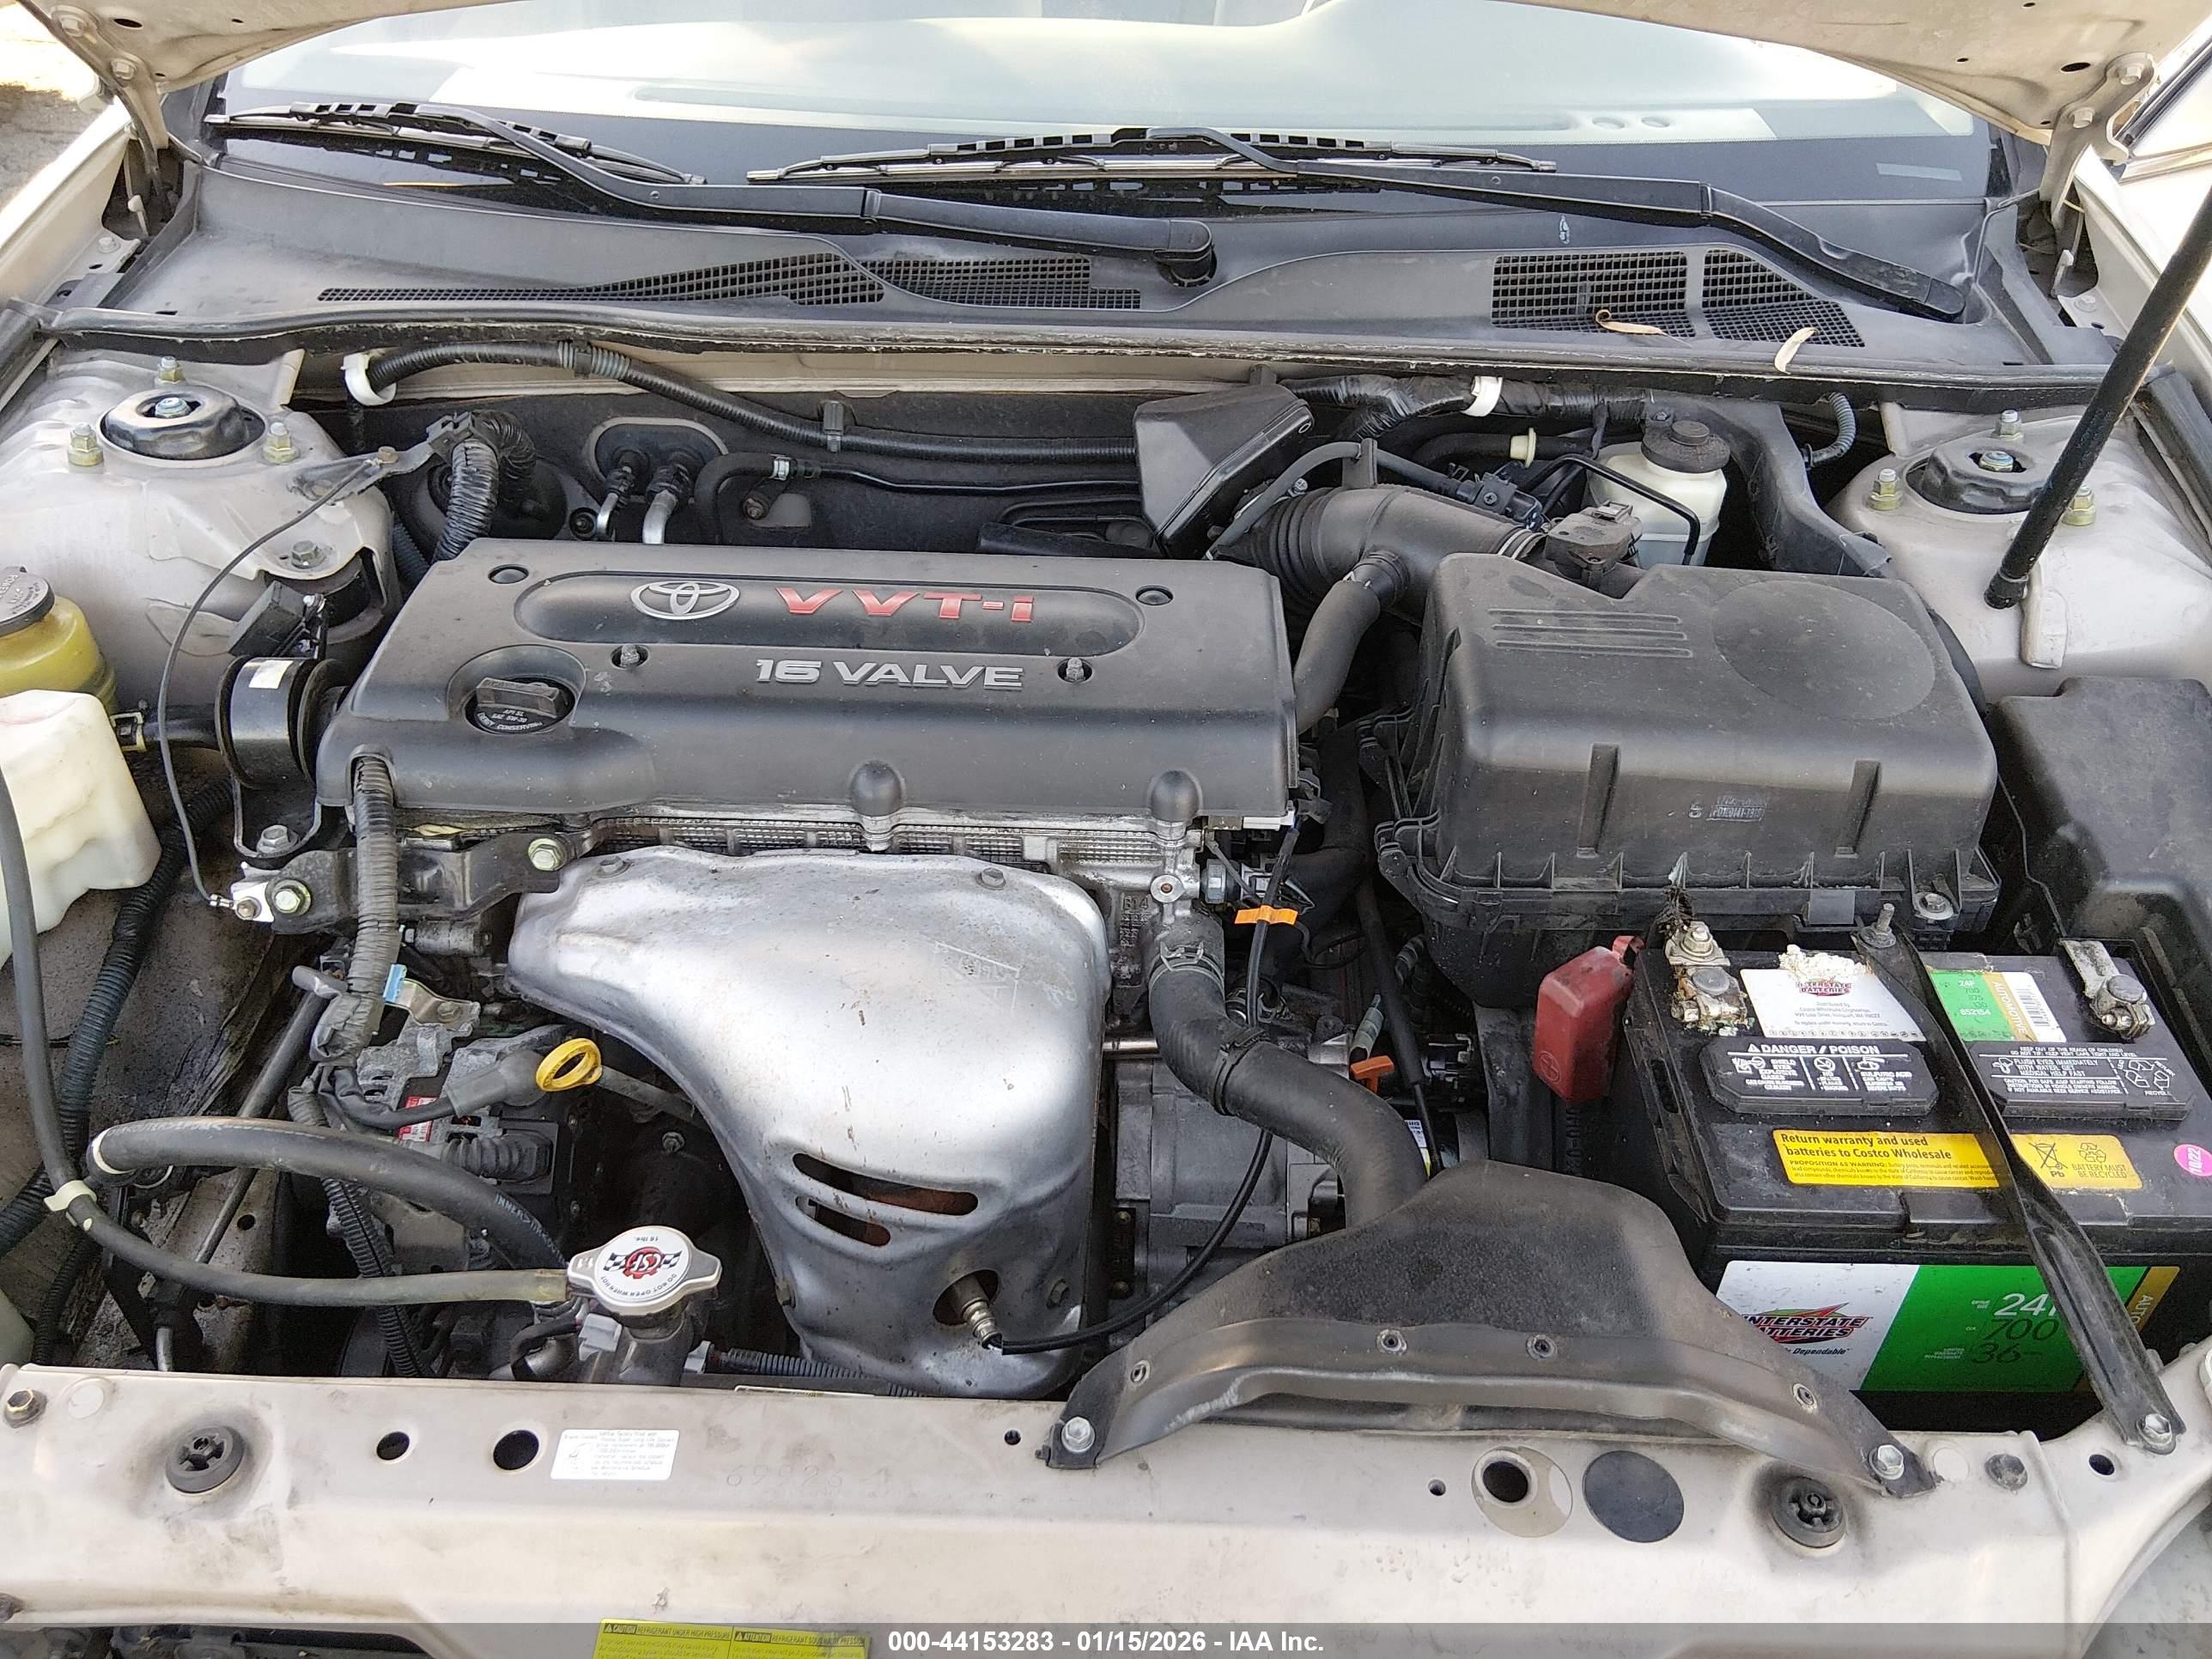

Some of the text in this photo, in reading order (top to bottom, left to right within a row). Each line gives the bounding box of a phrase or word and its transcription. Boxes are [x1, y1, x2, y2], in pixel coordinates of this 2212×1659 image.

[756, 659, 1024, 690] 16 VALVE
[1992, 981, 2027, 1034] AUTOMOTIVE
[1761, 1044, 1880, 1054] DANGER / POISON
[1781, 1133, 1929, 1147] Return warranty and used
[1785, 1146, 1952, 1159] batteries to Costco Wholesale
[631, 1253, 662, 1271] CSF
[667, 1273, 678, 1282] DO
[610, 1285, 628, 1297] WHEN
[653, 1282, 668, 1292] NOT
[1984, 1318, 2059, 1340] 700
[1793, 1347, 1846, 1356] Dependable
[613, 1625, 635, 1633] CAUTION
[637, 1626, 671, 1636] REFRIGERANT
[744, 1633, 770, 1642] ATTENTION
